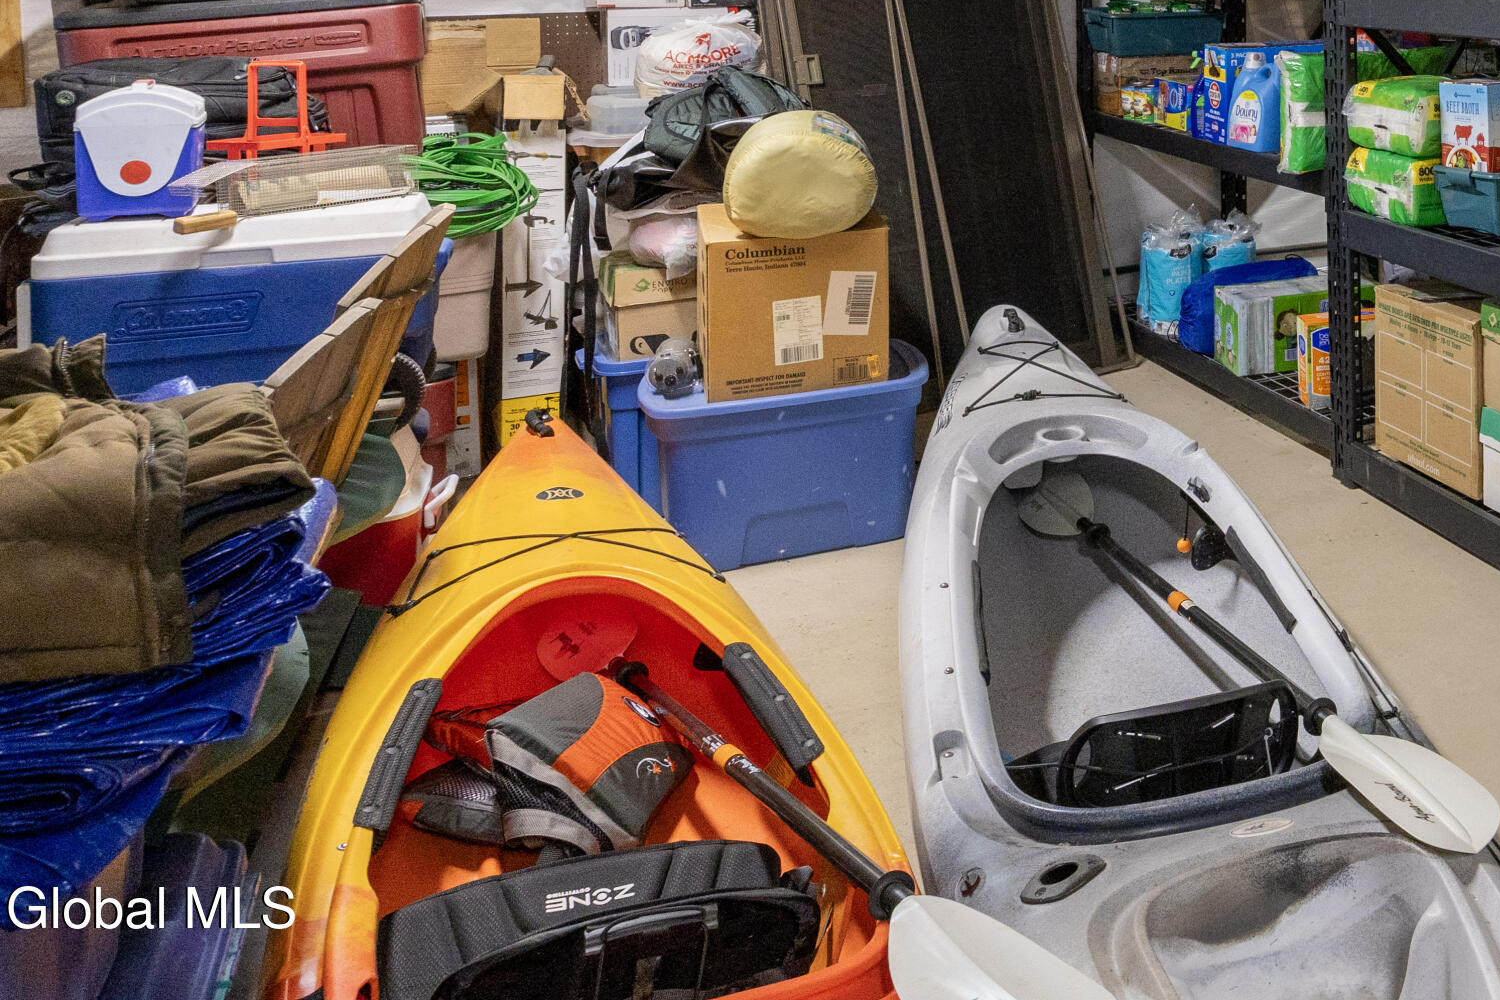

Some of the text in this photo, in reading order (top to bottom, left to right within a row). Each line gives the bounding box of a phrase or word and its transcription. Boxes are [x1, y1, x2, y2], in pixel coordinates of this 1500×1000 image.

[1150, 68, 1167, 76] Top
[1235, 105, 1258, 123] Downy
[1446, 100, 1480, 115] BEEF BROTH
[725, 245, 805, 260] Columbian
[652, 278, 687, 288] ENVIRO
[1408, 454, 1440, 477] uhaul.com
[545, 883, 635, 913] ZONE
